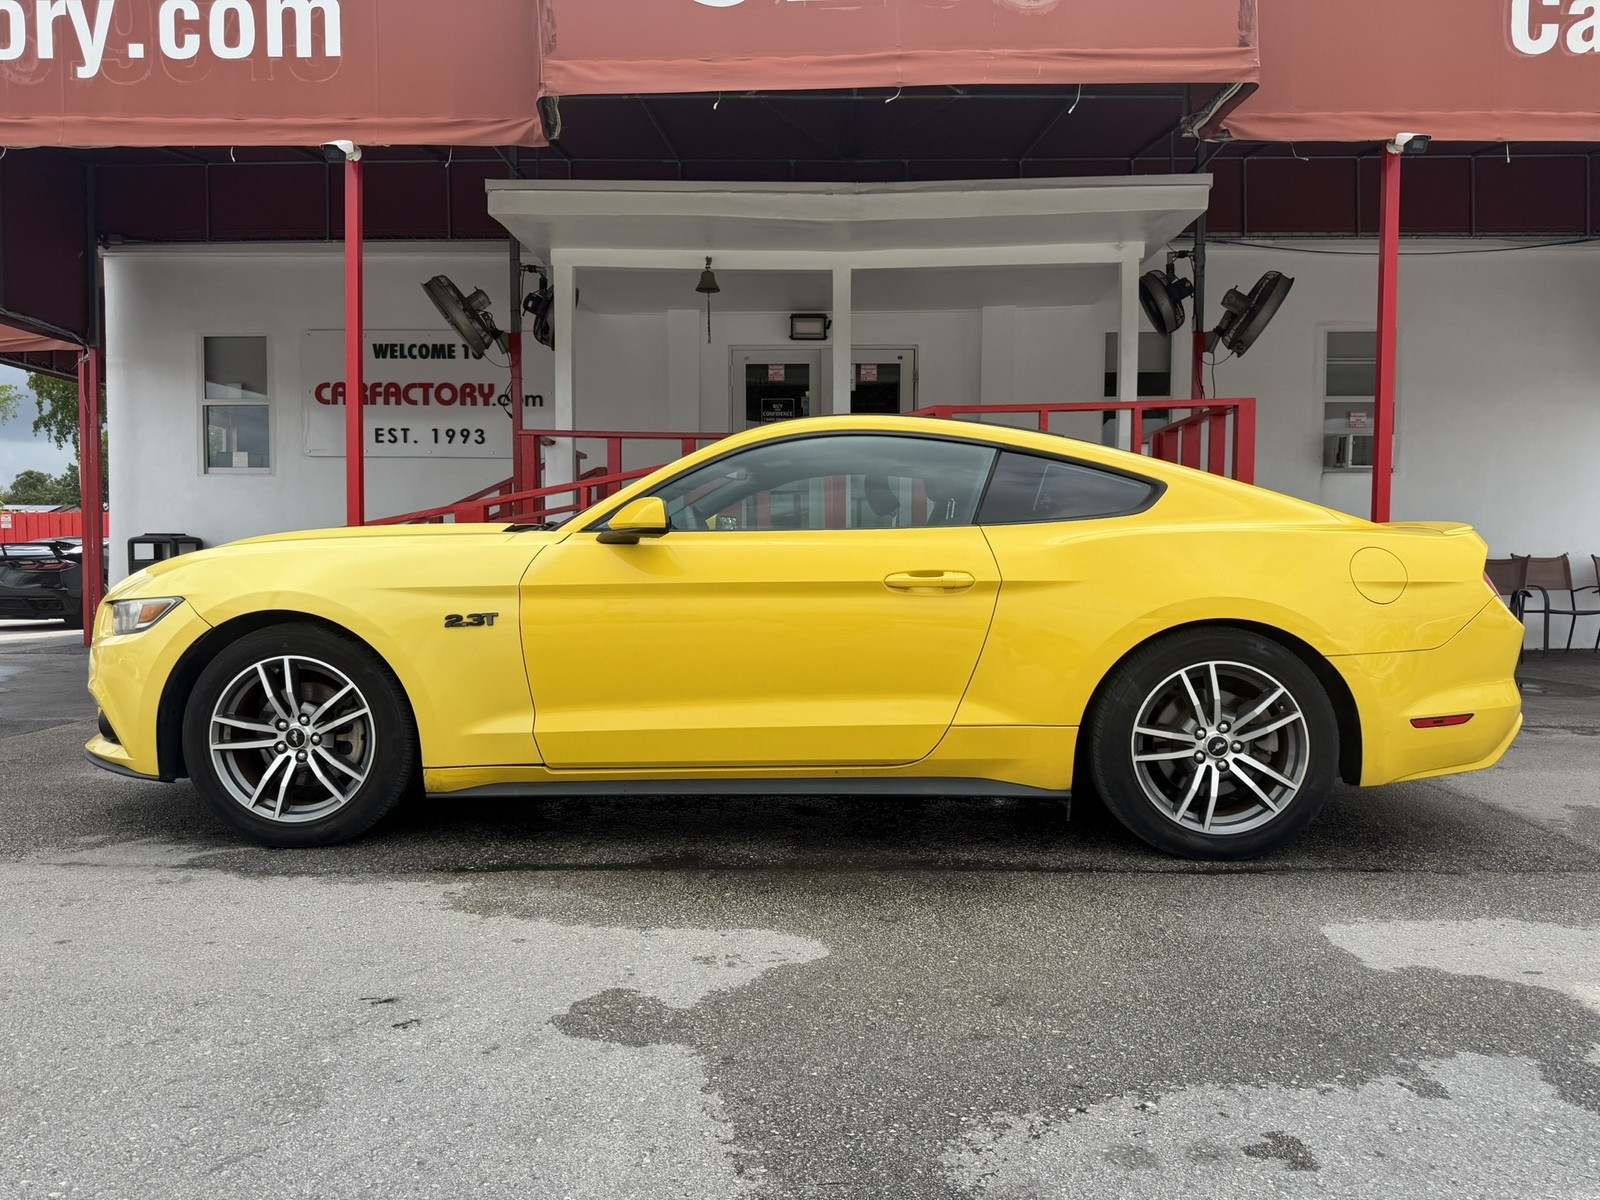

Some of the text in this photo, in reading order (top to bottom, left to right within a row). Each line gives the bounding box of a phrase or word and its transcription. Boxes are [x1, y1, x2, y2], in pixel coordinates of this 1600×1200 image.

[372, 343, 456, 360] WELCOME
[314, 382, 544, 407] CAFACTORY.cm
[374, 428, 486, 445] EST. 1993
[444, 612, 499, 628] 2.3T
